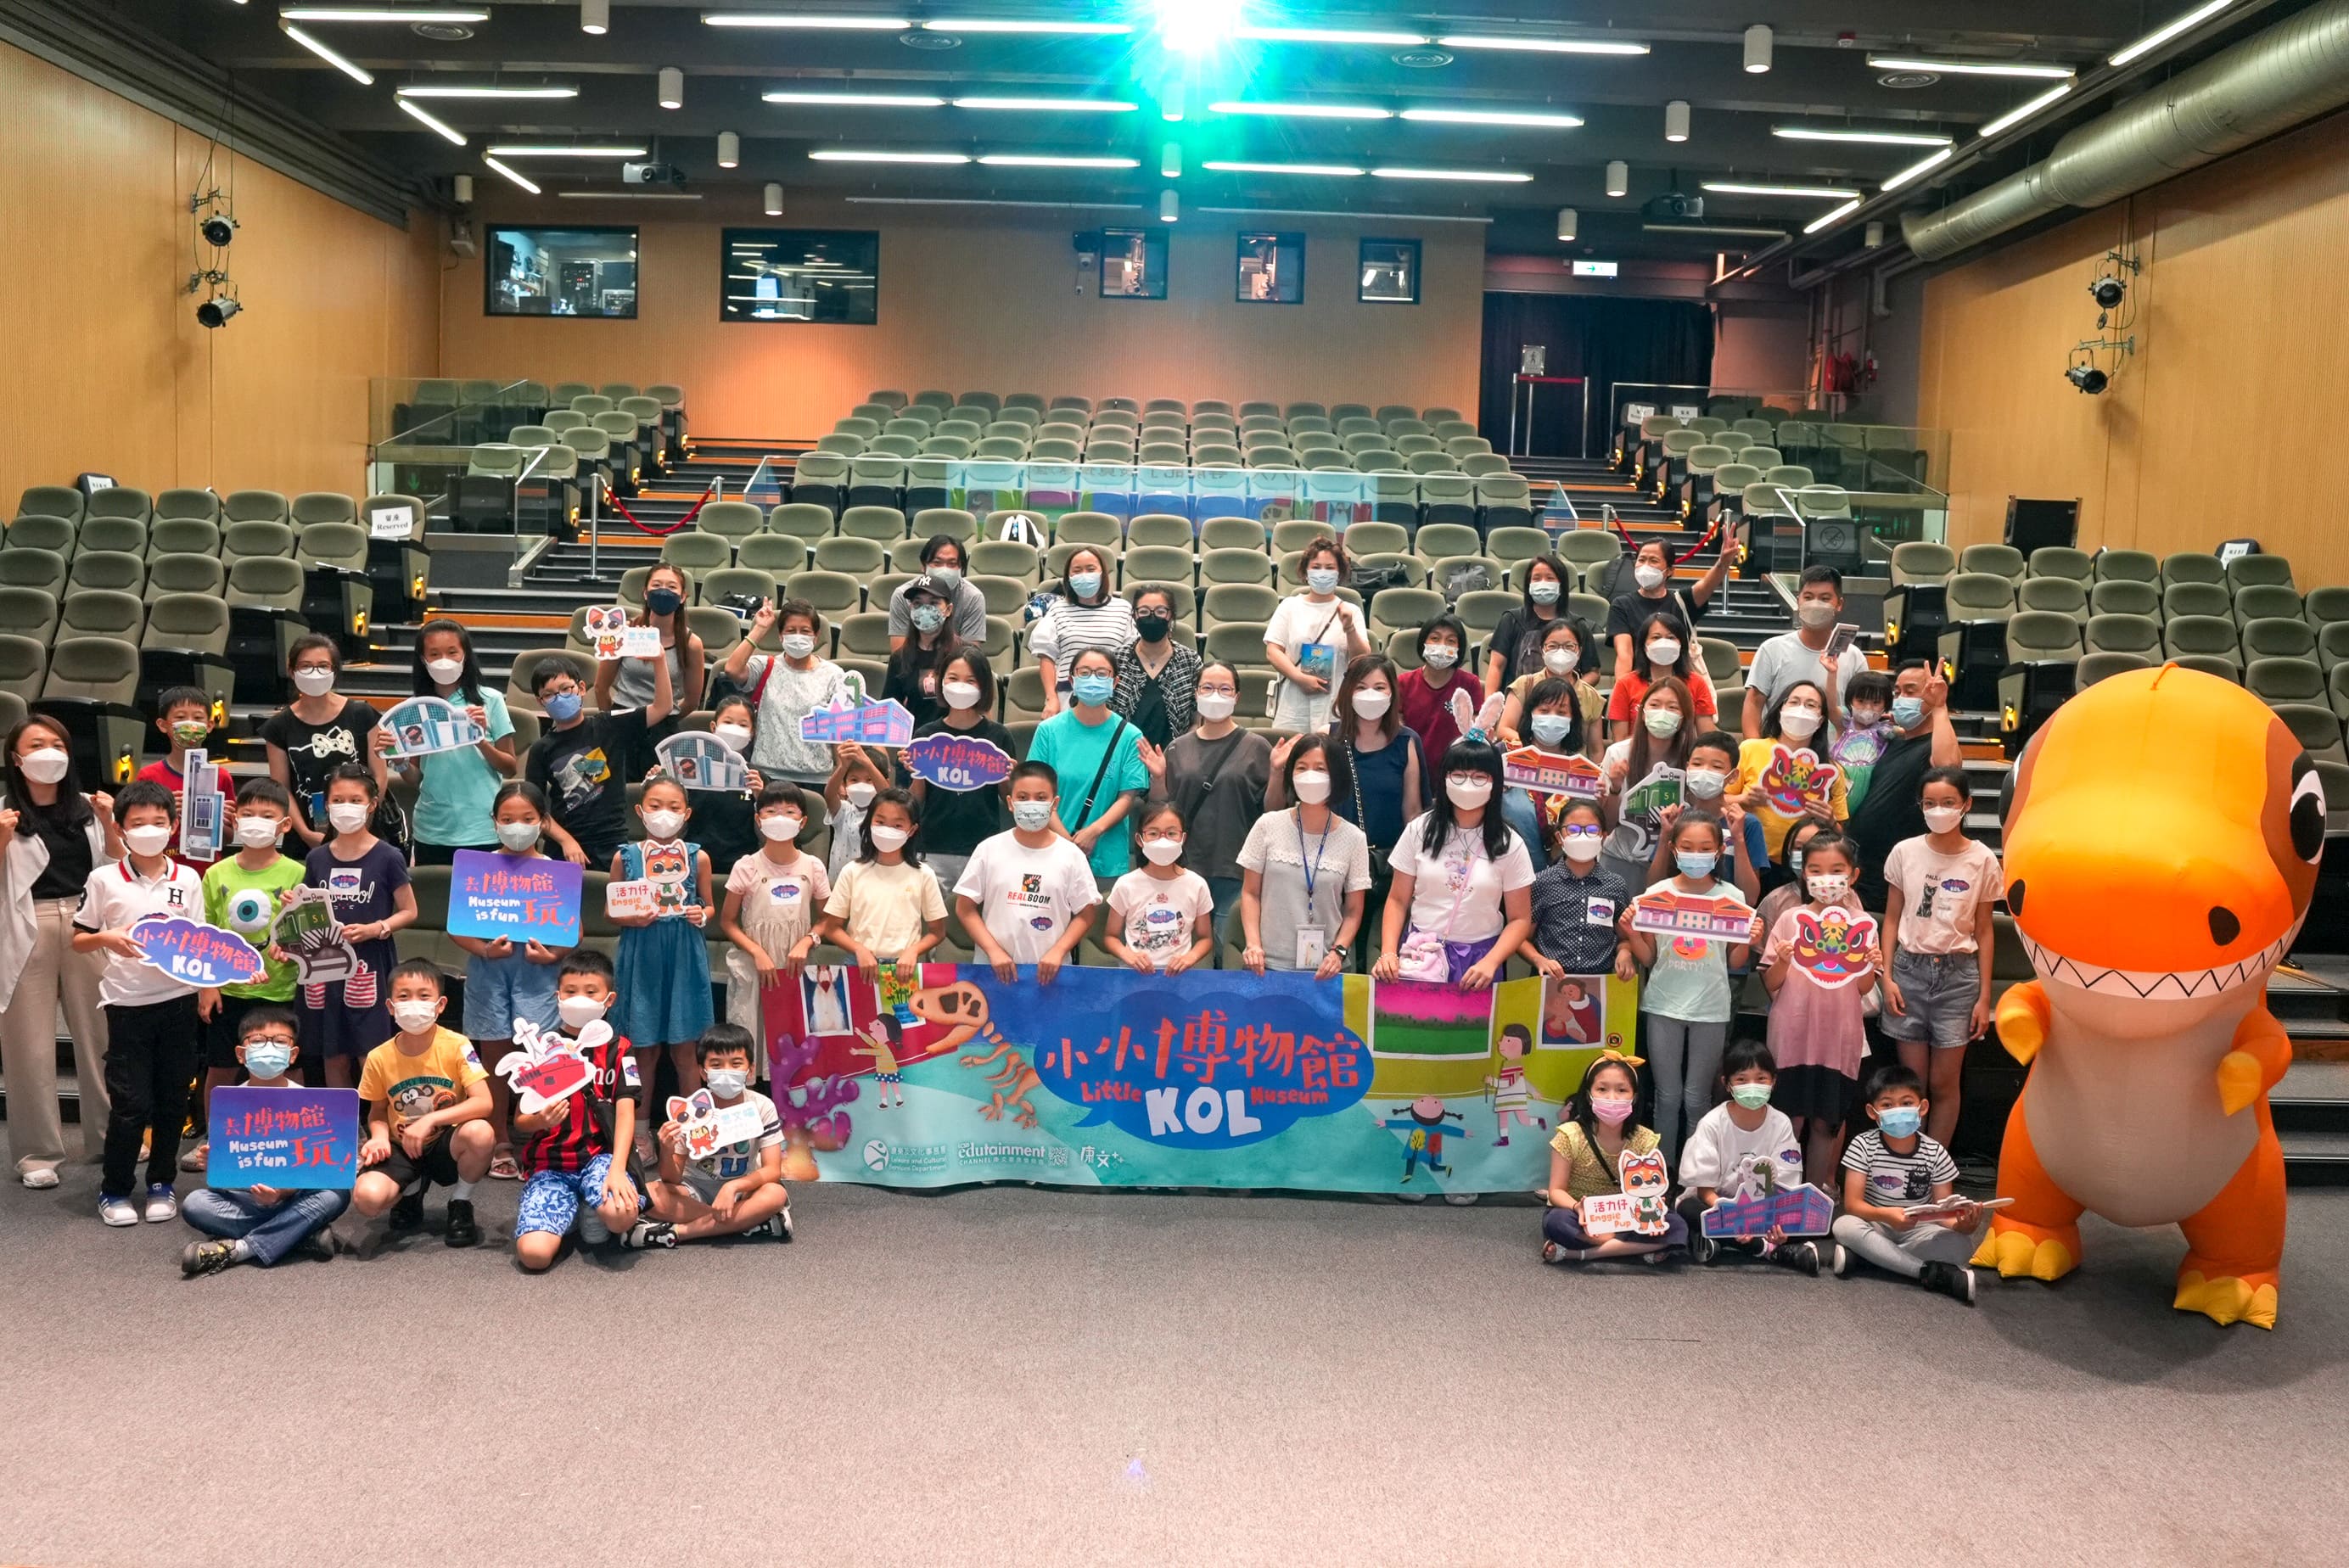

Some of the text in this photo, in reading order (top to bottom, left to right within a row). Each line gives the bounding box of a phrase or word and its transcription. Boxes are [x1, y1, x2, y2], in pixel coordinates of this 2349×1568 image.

[918, 576, 932, 585] NY
[938, 766, 973, 786] KOL
[168, 888, 183, 904] H
[616, 885, 649, 898] 活力仔
[468, 896, 521, 908] Museum
[611, 897, 642, 906] Enggie
[475, 908, 519, 923] is fun
[136, 928, 258, 972] 小小博物館
[172, 955, 216, 982] KOL
[1045, 1009, 1360, 1090] 小小博物館
[1081, 1080, 1141, 1102] Little
[1251, 1086, 1329, 1106] Museum
[1146, 1086, 1262, 1137] KOL
[229, 1139, 289, 1153] Museum
[958, 1141, 1046, 1158] edutainment
[238, 1152, 287, 1168] is fun
[959, 1156, 991, 1165] CHANNEL
[1594, 1199, 1628, 1212] 活力仔
[1589, 1212, 1621, 1222] Enggie
